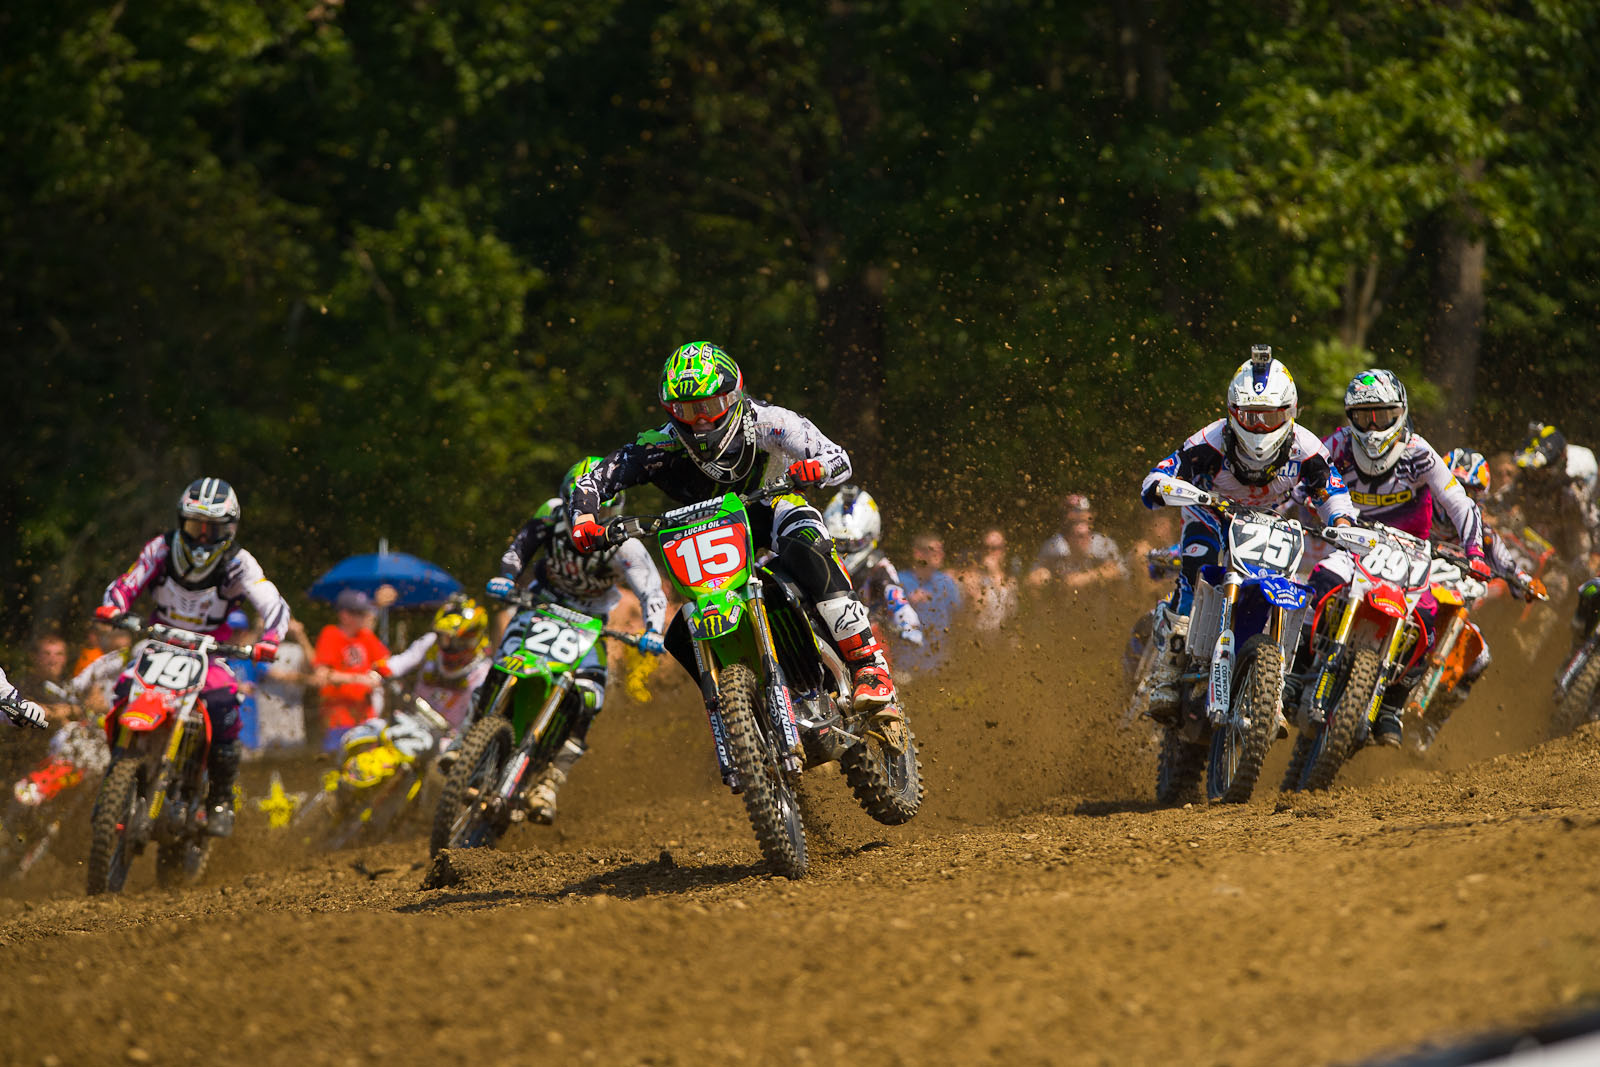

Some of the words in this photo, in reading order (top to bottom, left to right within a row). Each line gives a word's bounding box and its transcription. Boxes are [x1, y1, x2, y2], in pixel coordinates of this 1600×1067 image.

[701, 462, 724, 480] VANS
[664, 495, 726, 518] RENTHA
[1350, 490, 1412, 506] GEICO
[683, 523, 707, 537] LUCAS
[707, 520, 721, 529] OIL
[1236, 523, 1298, 568] 25
[675, 527, 741, 585] 15
[143, 651, 202, 690] 19
[774, 685, 796, 747] DUNLOP
[710, 712, 729, 767] UNLOP
